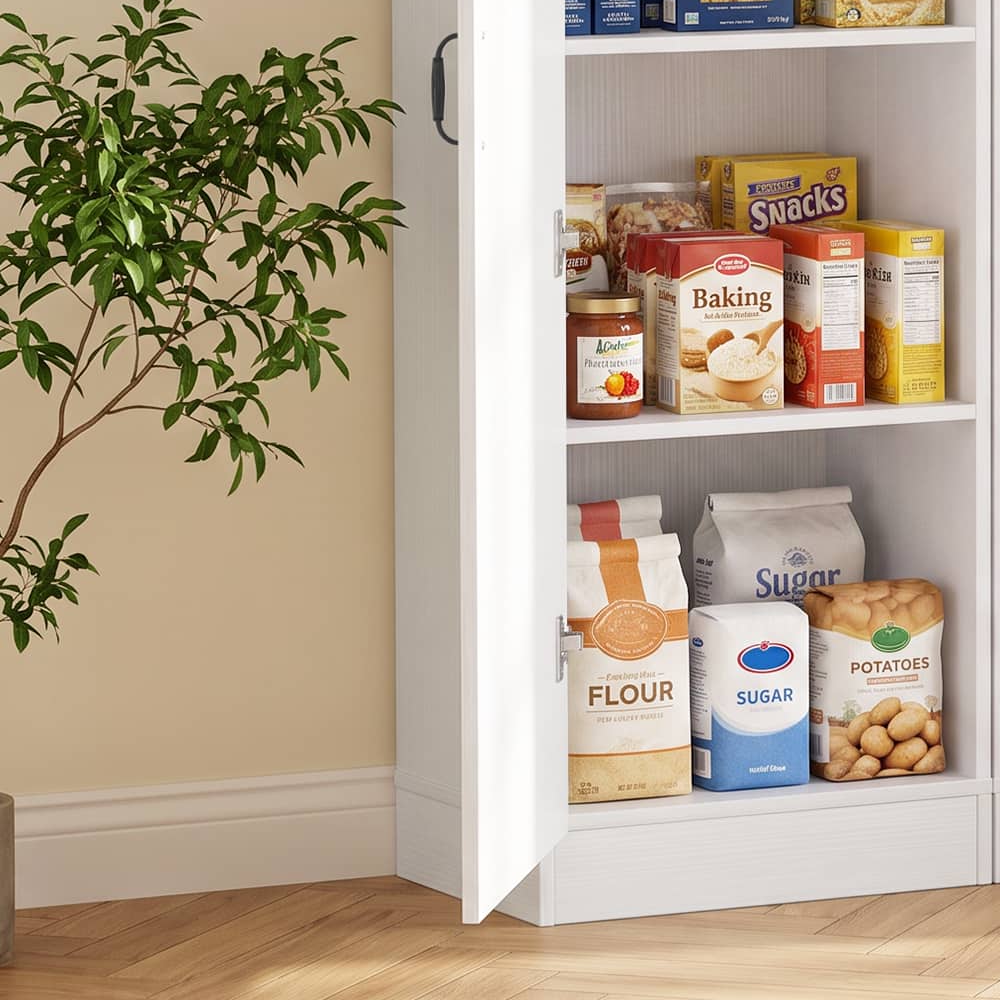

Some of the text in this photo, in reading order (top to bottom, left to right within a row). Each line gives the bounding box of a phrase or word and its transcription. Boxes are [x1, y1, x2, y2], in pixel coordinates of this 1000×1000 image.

[692, 285, 773, 312] Baking
[756, 567, 841, 599] Sugar
[850, 657, 930, 674] POTATOES
[588, 680, 674, 706] FLOUR
[736, 687, 794, 705] SUGAR
